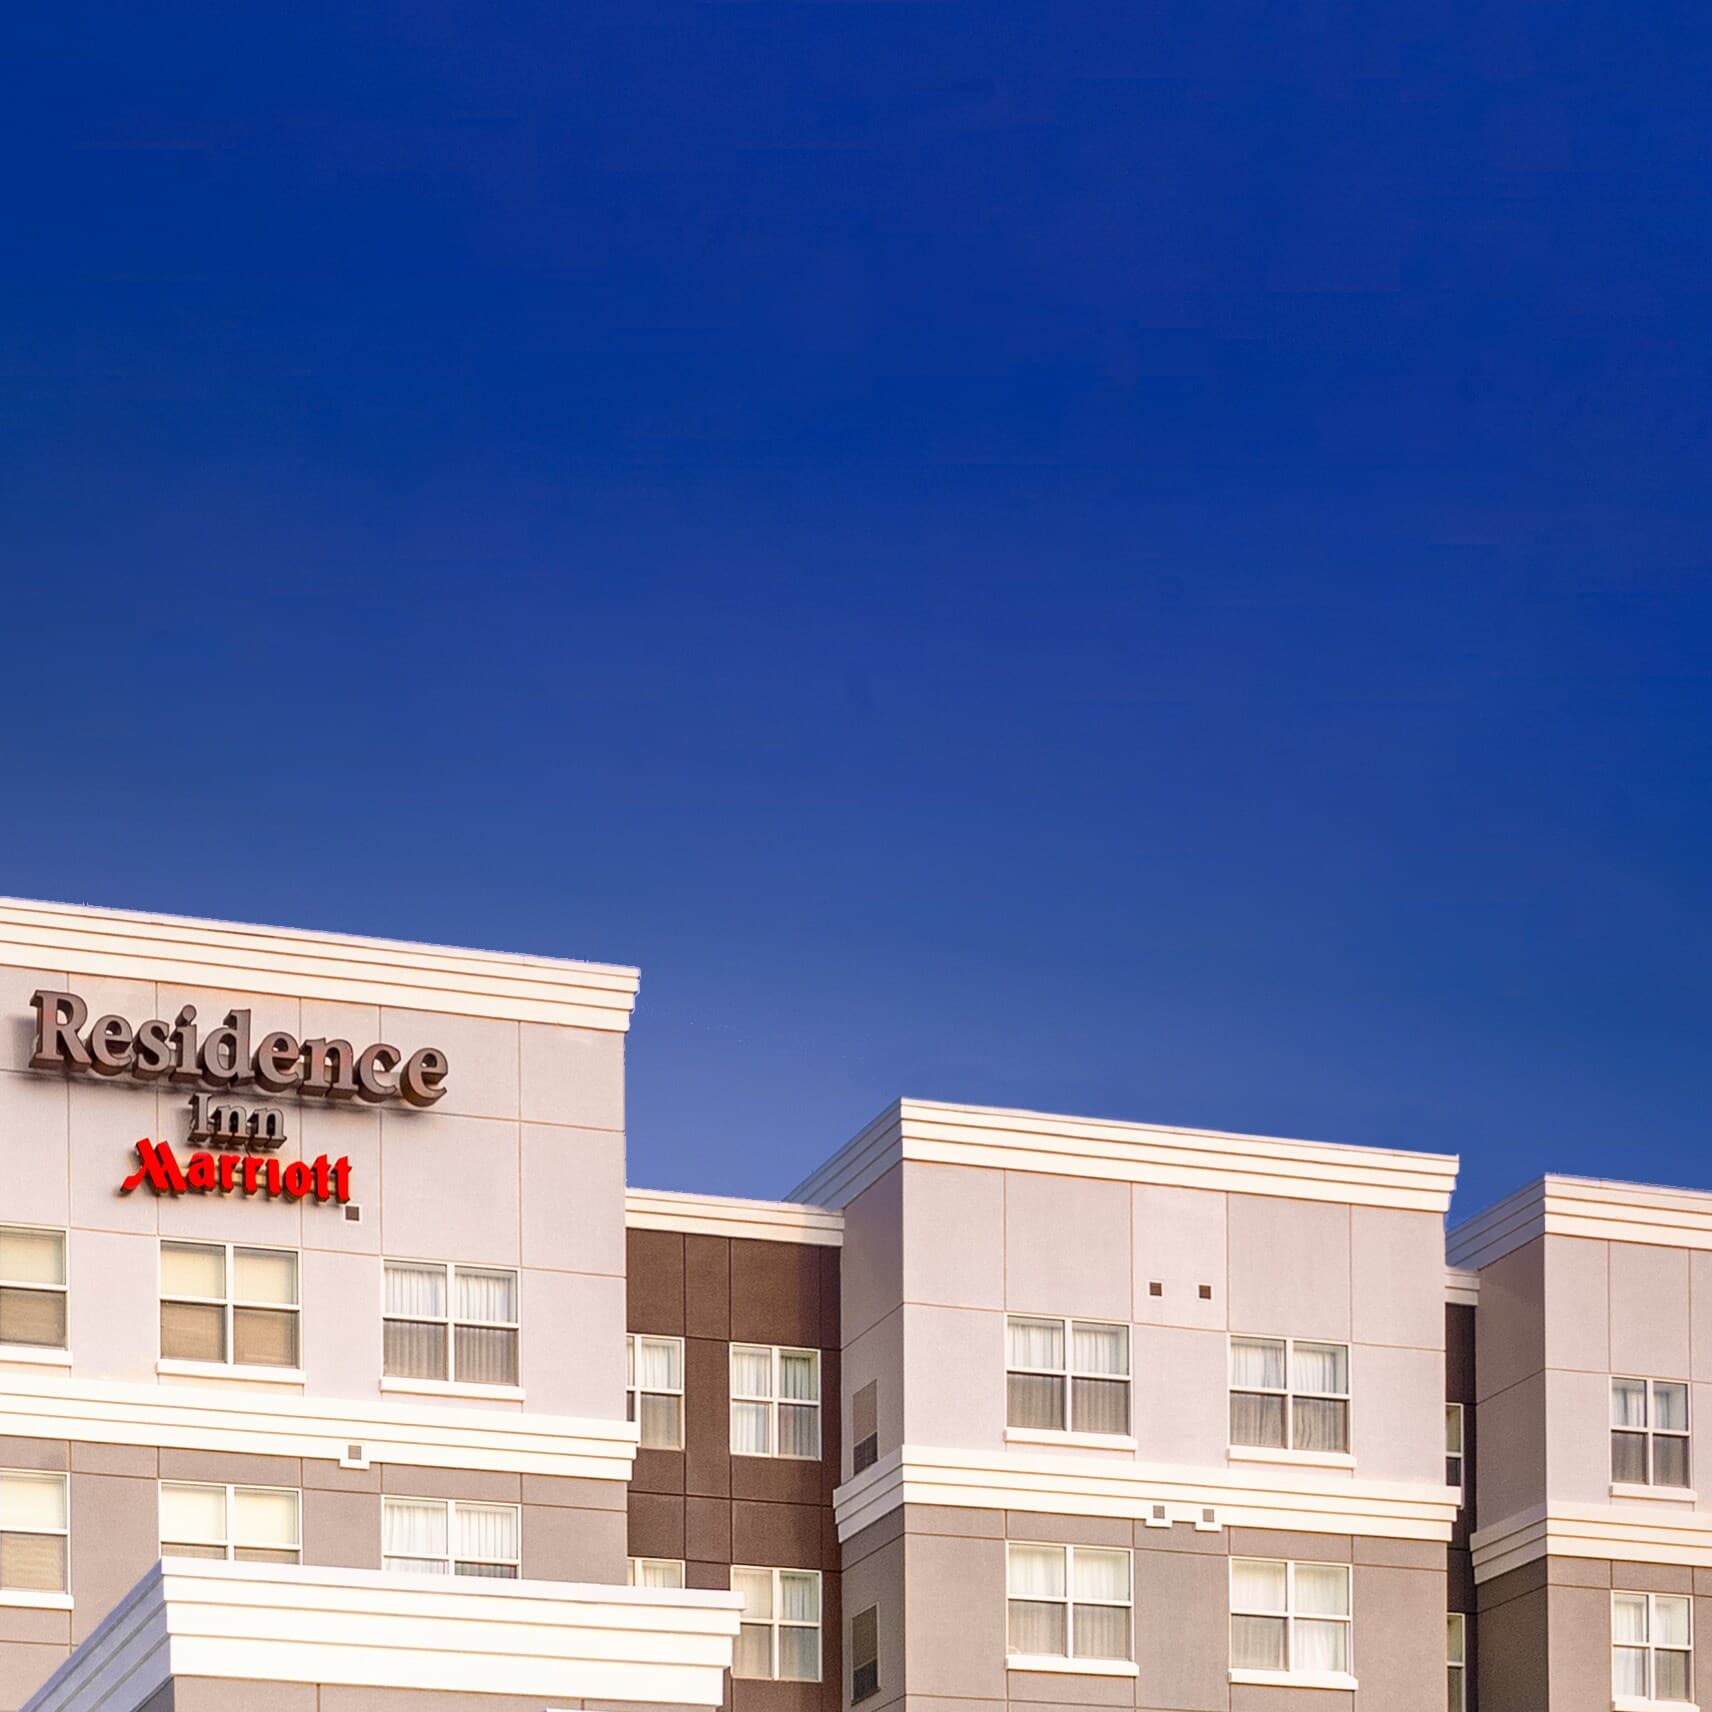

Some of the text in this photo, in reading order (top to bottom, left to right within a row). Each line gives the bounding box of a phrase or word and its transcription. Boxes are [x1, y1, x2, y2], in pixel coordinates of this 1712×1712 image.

[29, 989, 448, 1107] Residence
[188, 1092, 287, 1149] Inn
[120, 1138, 352, 1204] Marriott
